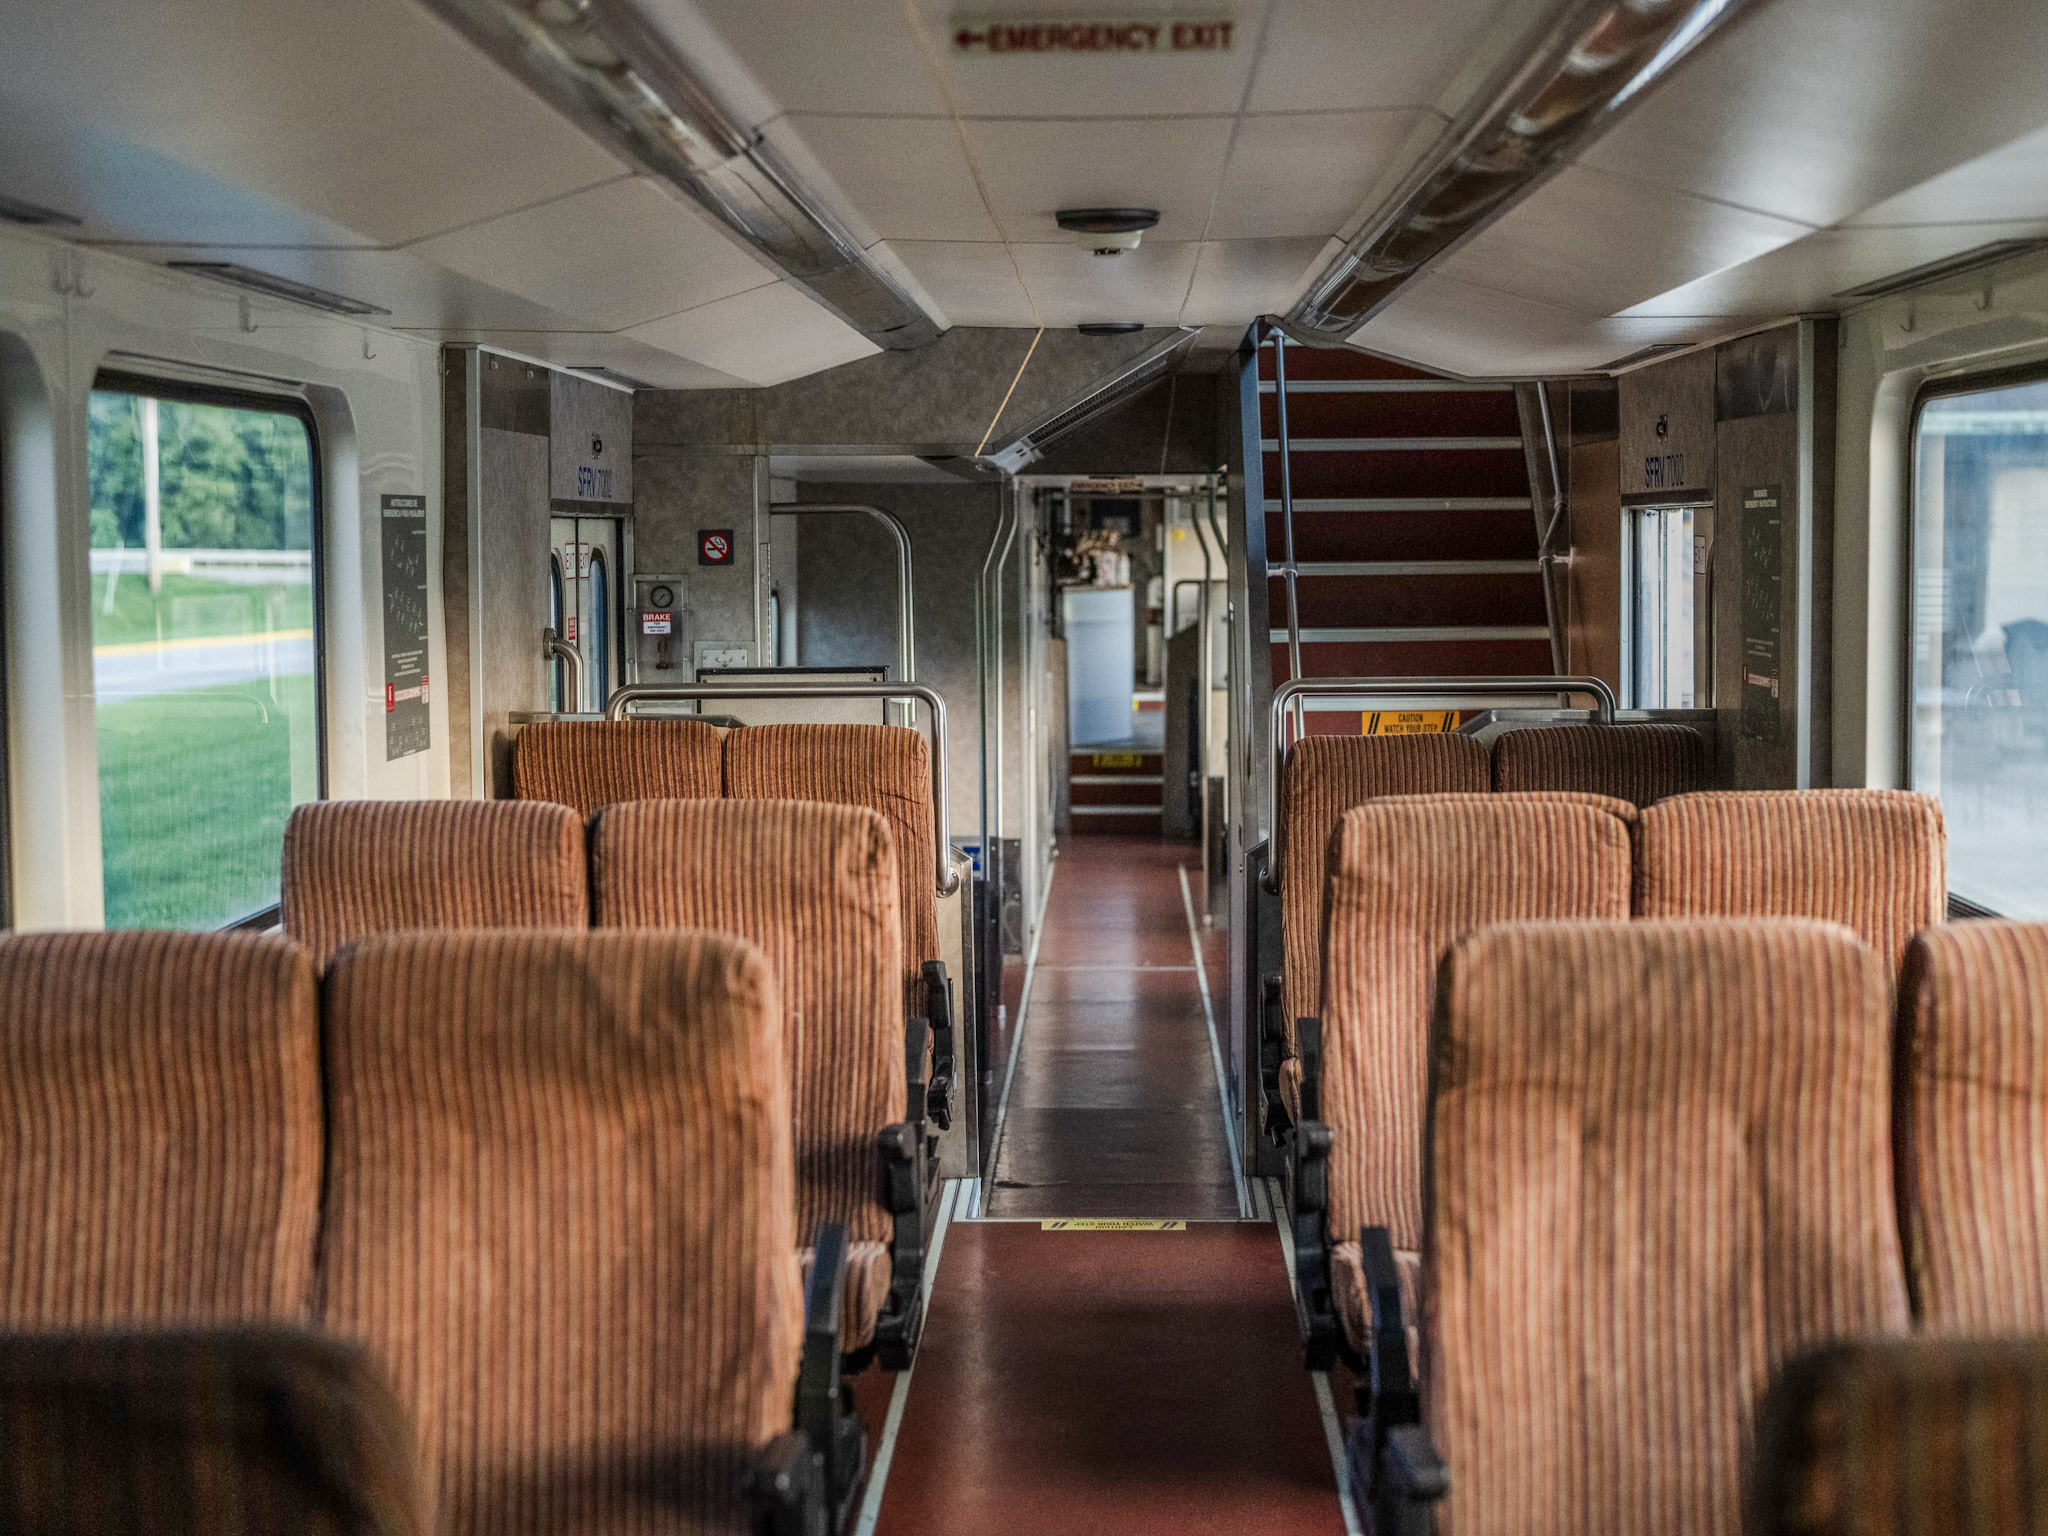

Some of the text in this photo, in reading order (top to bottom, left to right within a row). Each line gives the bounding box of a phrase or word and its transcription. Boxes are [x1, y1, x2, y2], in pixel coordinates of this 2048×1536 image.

[988, 21, 1233, 51] EMERGENCY EXIT
[1645, 456, 1665, 488] SFRV
[578, 466, 597, 498] SFRV
[566, 552, 576, 570] EXIT
[579, 552, 589, 570] EXIT
[1398, 713, 1424, 722] CAUTION
[1384, 723, 1438, 733] WATCH YOUR STEP
